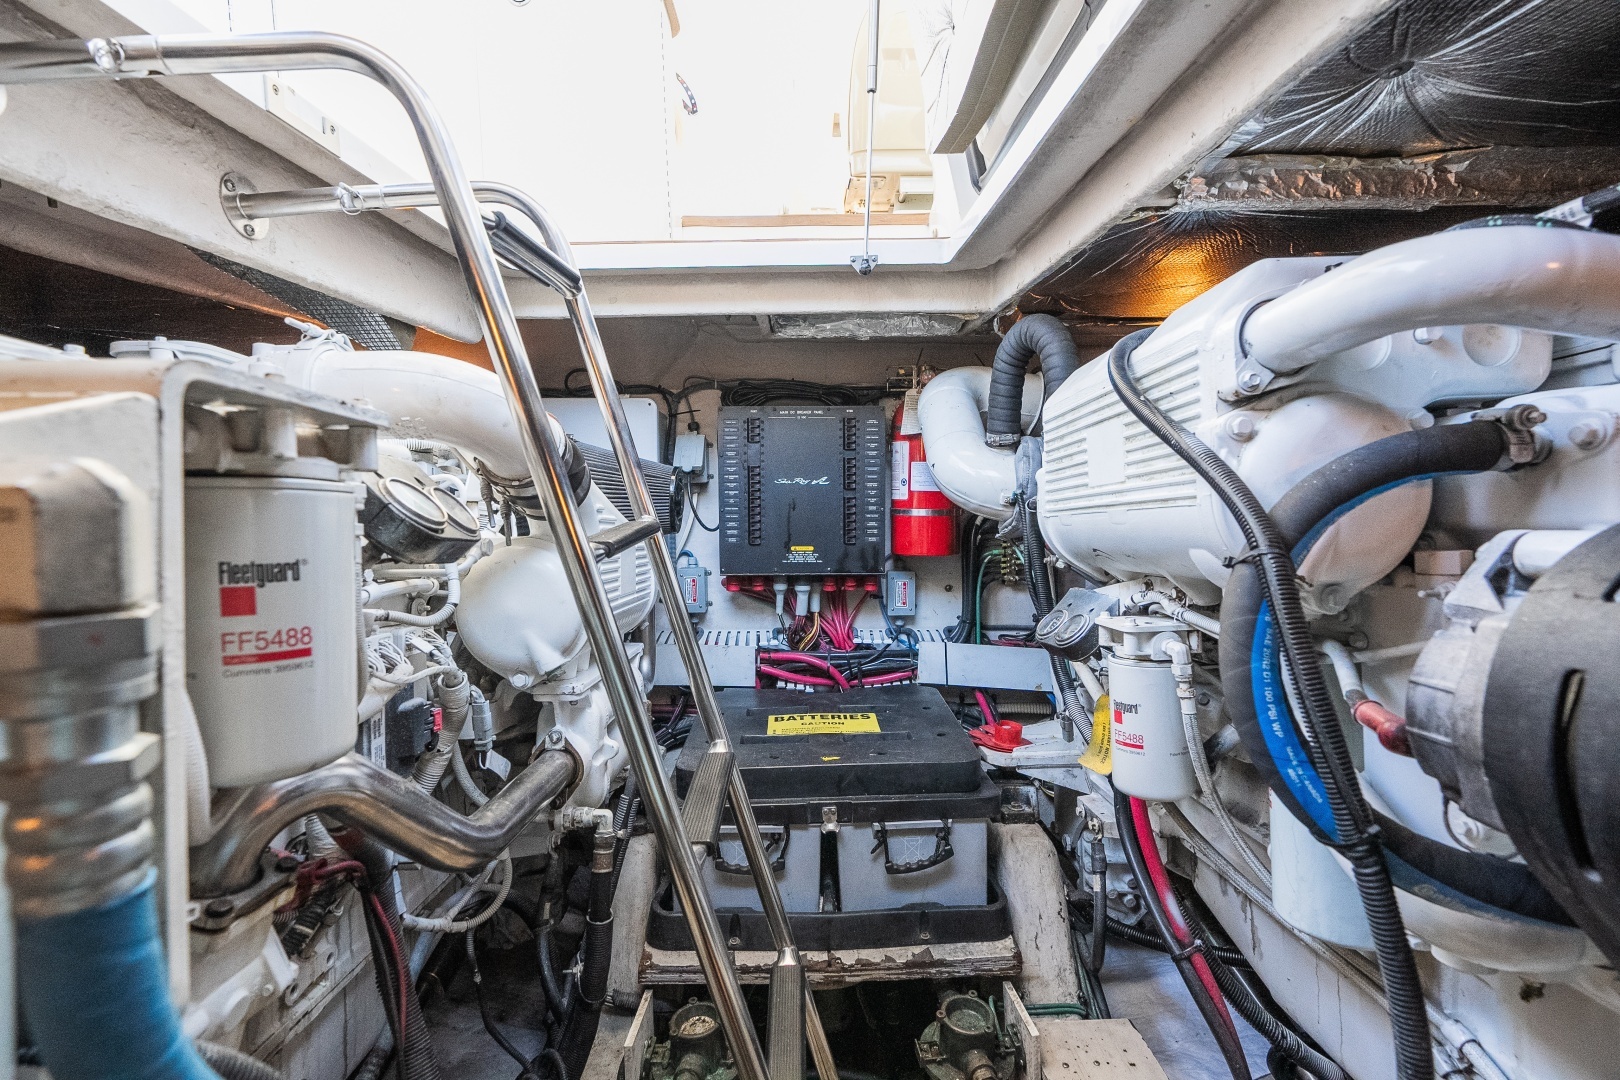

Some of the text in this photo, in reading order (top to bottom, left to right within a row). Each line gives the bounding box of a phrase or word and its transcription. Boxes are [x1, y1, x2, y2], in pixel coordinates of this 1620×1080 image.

[218, 559, 300, 588] Fleetguard
[220, 626, 312, 653] FF5488
[1264, 687, 1274, 702] 100
[1113, 699, 1138, 714] Fleetguard
[1267, 704, 1278, 720] PSI
[773, 713, 871, 722] BATTERIES
[1114, 729, 1144, 744] FF5488
[1271, 721, 1284, 738] WP
